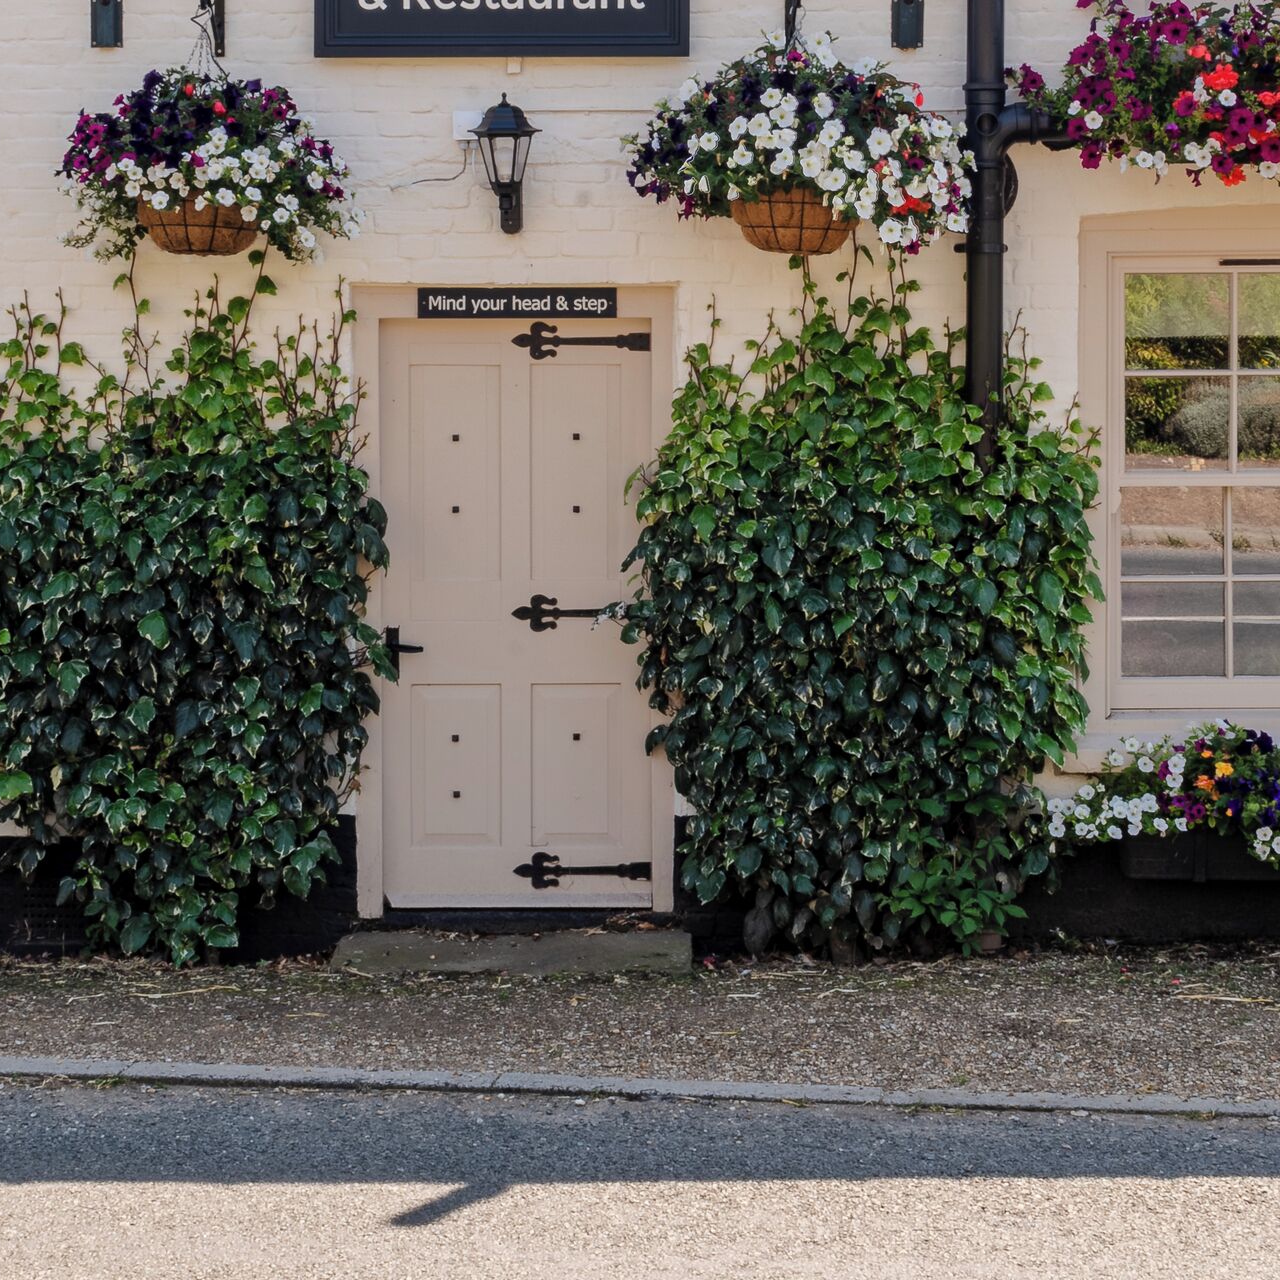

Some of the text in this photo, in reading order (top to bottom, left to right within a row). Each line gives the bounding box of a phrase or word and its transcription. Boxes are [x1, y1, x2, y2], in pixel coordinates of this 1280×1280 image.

[429, 296, 607, 313] Mind your head & step
